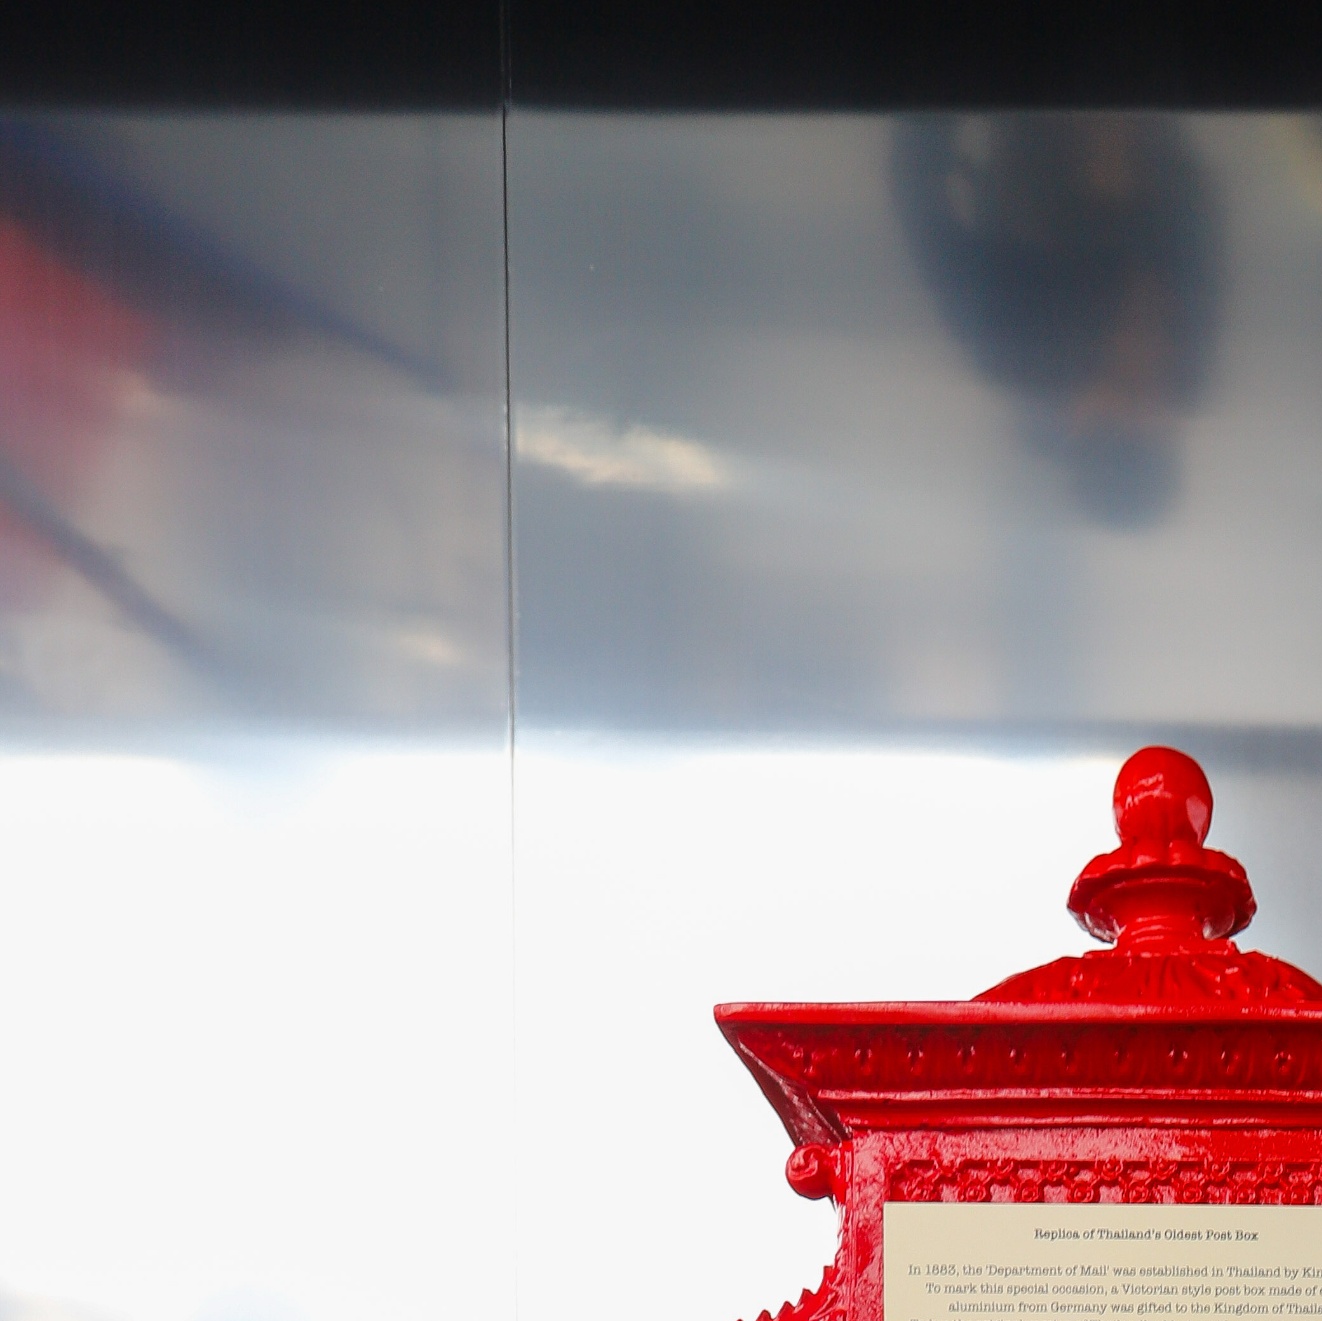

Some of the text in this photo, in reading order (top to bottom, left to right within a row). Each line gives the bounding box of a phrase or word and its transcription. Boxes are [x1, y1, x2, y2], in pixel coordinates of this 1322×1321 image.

[1034, 1228, 1259, 1242] Replica of Thailand's Oldest Post Box
[908, 1264, 921, 1276] In
[963, 1264, 983, 1276] the
[1065, 1264, 1078, 1277] of
[1113, 1268, 1137, 1277] was
[1139, 1265, 1208, 1277] established
[1211, 1266, 1224, 1278] in
[1226, 1266, 1281, 1278] Thailand
[1284, 1267, 1298, 1280] by
[926, 1283, 941, 1294] To
[944, 1283, 977, 1294] mark
[980, 1283, 1004, 1294] this
[1007, 1283, 1049, 1297] special
[1052, 1284, 1108, 1297] occasion,
[1111, 1287, 1119, 1295] a
[1122, 1284, 1178, 1295] Victorian
[1181, 1284, 1211, 1298] style
[1215, 1286, 1241, 1298] post
[1243, 1285, 1265, 1296] box
[1268, 1285, 1302, 1297] made
[1305, 1285, 1318, 1297] of
[948, 1301, 1015, 1313] aluminium
[1018, 1301, 1047, 1313] from
[1050, 1301, 1107, 1315] Germany
[1110, 1305, 1134, 1313] was
[1137, 1302, 1172, 1316] gifted
[1175, 1304, 1188, 1314] to
[1190, 1302, 1210, 1314] the
[1214, 1302, 1269, 1316] Kingdom
[1272, 1303, 1285, 1315] of
